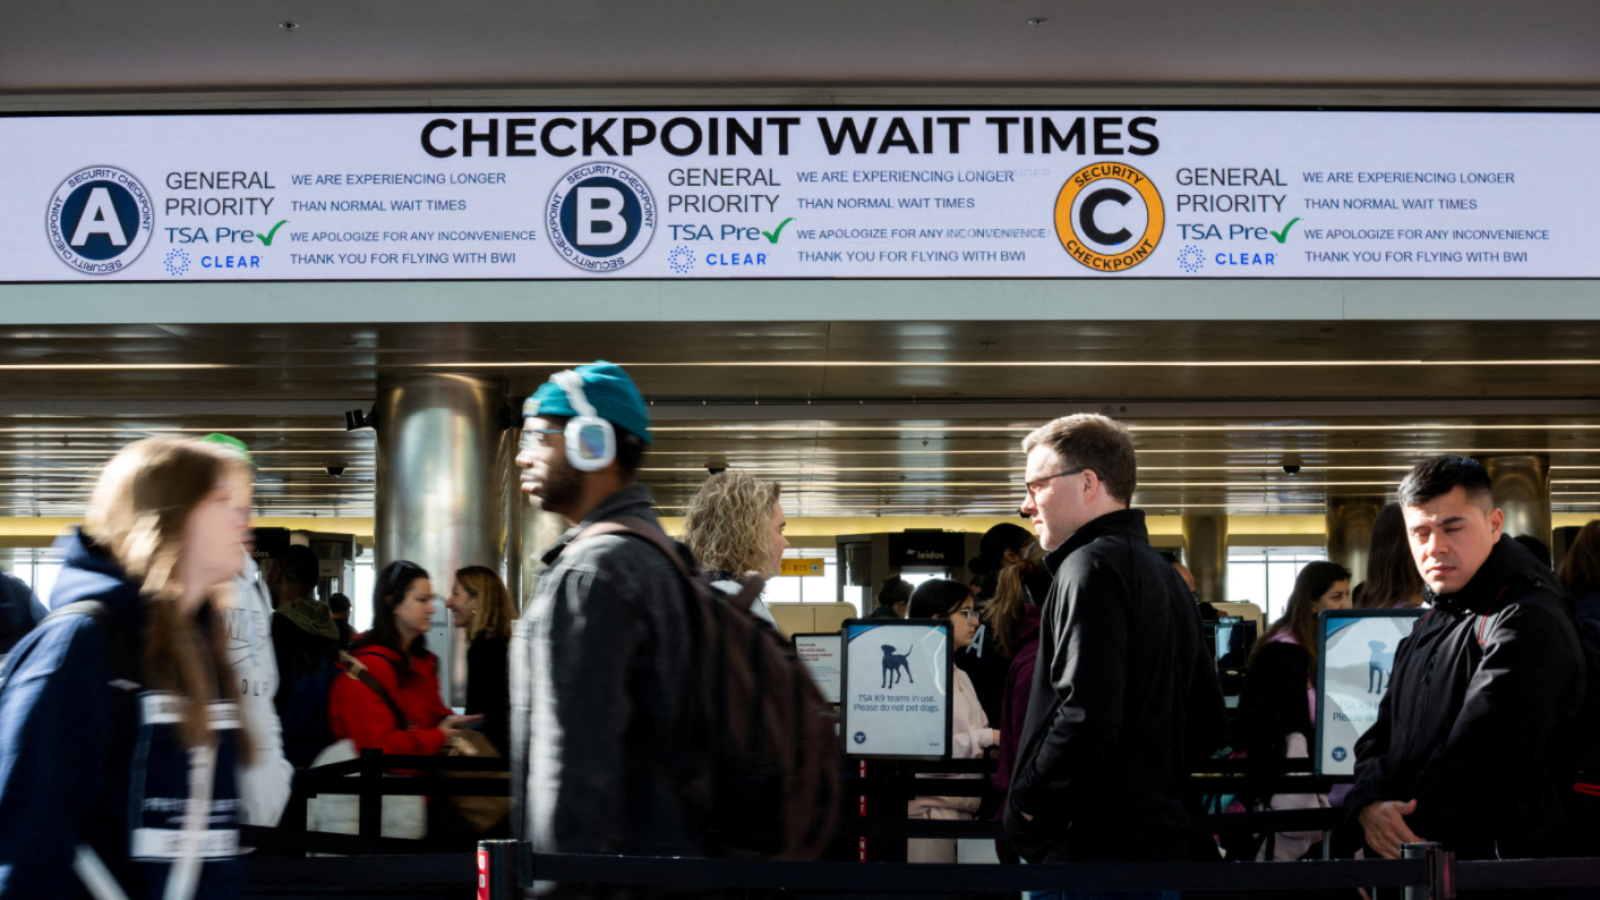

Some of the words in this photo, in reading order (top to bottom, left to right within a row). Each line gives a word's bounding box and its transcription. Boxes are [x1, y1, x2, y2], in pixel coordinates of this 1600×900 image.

[421, 118, 800, 157] CHECKPOINT
[817, 117, 970, 155] WAIT
[986, 117, 1159, 156] TIMES
[166, 171, 275, 189] GENERAL
[292, 175, 312, 185] WE
[316, 174, 342, 185] ARE
[346, 174, 446, 185] EXPERIENCING
[450, 173, 505, 184] LONGER
[668, 168, 781, 186] GENERAL
[797, 172, 817, 182] WE
[822, 171, 848, 182] ARE
[853, 171, 954, 182] EXPERIENCING
[958, 171, 1014, 182] LONGER
[1074, 165, 1144, 188] SECURITY
[1176, 168, 1287, 186] GENERAL
[1303, 172, 1323, 182] WE
[1327, 172, 1353, 182] ARE
[1358, 172, 1456, 183] EXPERIENCING
[1461, 173, 1515, 183] LONGER
[67, 169, 118, 188] SECURITY
[118, 174, 151, 232] CHECKPOINT
[566, 165, 619, 184] SECURITY
[619, 171, 653, 229] CHECKPOINT
[797, 198, 833, 209] THAN
[838, 198, 892, 208] NORMAL
[898, 198, 931, 208] WAIT
[934, 198, 975, 208] TIMES
[1177, 195, 1286, 212] PRIORITY
[1305, 198, 1339, 209] THAN
[1344, 199, 1399, 209] NORMAL
[1403, 199, 1434, 209] WAIT
[1438, 199, 1477, 209] TIMES
[166, 197, 274, 216] PRIORITY
[291, 201, 326, 211] THAN
[331, 201, 386, 211] NORMAL
[390, 200, 422, 211] WAIT
[426, 200, 466, 210] TIMES
[669, 195, 779, 213] PRIORITY
[70, 187, 128, 246] A
[576, 186, 627, 246] B
[1079, 187, 1133, 246] C
[50, 195, 73, 260] CHECKPOINT
[549, 192, 574, 257] CHECKPOINT
[165, 227, 208, 243] TSA
[216, 228, 254, 243] Pre
[291, 232, 308, 242] WE
[312, 232, 379, 242] APOLOGIZE
[383, 232, 408, 241] FOR
[410, 232, 434, 241] ANY
[438, 231, 536, 241] INCONVENIENCE
[668, 224, 713, 240] TSA
[721, 225, 760, 240] Pre
[797, 230, 815, 239] WE
[819, 229, 887, 239] APOLOGIZE
[891, 229, 916, 238] FOR
[919, 229, 943, 238] ANY
[947, 229, 1045, 238] INCONVENIENCE
[1177, 224, 1222, 240] TSA
[1230, 224, 1267, 240] Pre
[1304, 230, 1323, 239] WE
[1326, 230, 1394, 239] APOLOGIZE
[1398, 230, 1423, 239] FOR
[1425, 230, 1449, 239] ANY
[1453, 230, 1549, 240] INCONVENIENCE
[290, 254, 334, 264] THANK
[338, 254, 366, 264] YOU
[371, 254, 398, 264] FOR
[403, 253, 449, 263] FLYING
[453, 253, 486, 263] WITH
[491, 253, 515, 263] BWI
[706, 253, 766, 265] CLEAR
[798, 251, 842, 262] THANK
[846, 252, 875, 262] YOU
[880, 251, 907, 262] FOR
[912, 251, 958, 262] FLYING
[962, 251, 996, 261] WITH
[1001, 251, 1025, 261] BWI
[1066, 239, 1154, 270] CHECKPOINT
[1215, 253, 1274, 265] CLEAR
[1305, 251, 1349, 262] THANK
[1353, 251, 1381, 262] YOU
[1386, 252, 1413, 262] FOR
[1417, 252, 1462, 262] FLYING
[1466, 252, 1499, 262] WITH
[1504, 252, 1527, 262] BWI
[71, 257, 123, 272] SECURITY
[201, 256, 259, 268] CLEAR
[572, 254, 625, 270] SECURITY
[917, 550, 945, 559] leidos
[794, 564, 807, 572] B15
[858, 694, 873, 702] TSA
[906, 704, 918, 712] pet
[920, 704, 939, 713] dogs.
[1338, 701, 1355, 710] TSA
[1359, 701, 1371, 710] K9
[1333, 712, 1363, 721] Please
